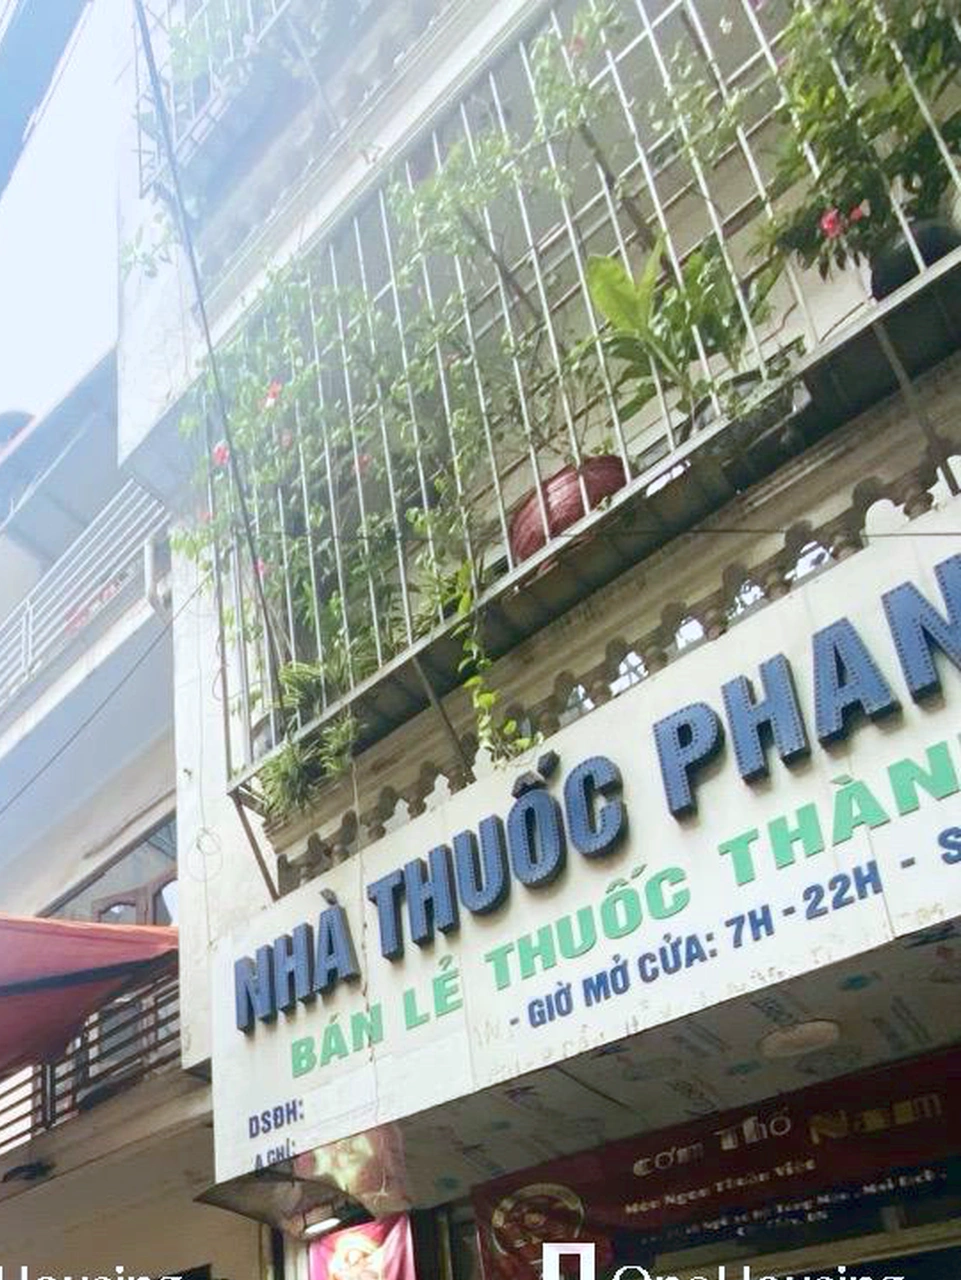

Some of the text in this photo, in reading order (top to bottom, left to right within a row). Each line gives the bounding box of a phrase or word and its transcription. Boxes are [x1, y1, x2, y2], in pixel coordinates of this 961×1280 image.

[234, 888, 361, 1033] NHÀ
[367, 750, 628, 962] THUỐC
[291, 1012, 384, 1078] BÁN
[403, 954, 463, 1030] LẺ
[484, 864, 691, 991] THUỐC
[718, 733, 961, 886] THÀN
[528, 981, 574, 1028] GIỜ
[582, 954, 630, 1008] MỞ
[638, 932, 717, 983] CỬA:
[725, 904, 775, 949] 7H
[802, 859, 883, 921] 22H
